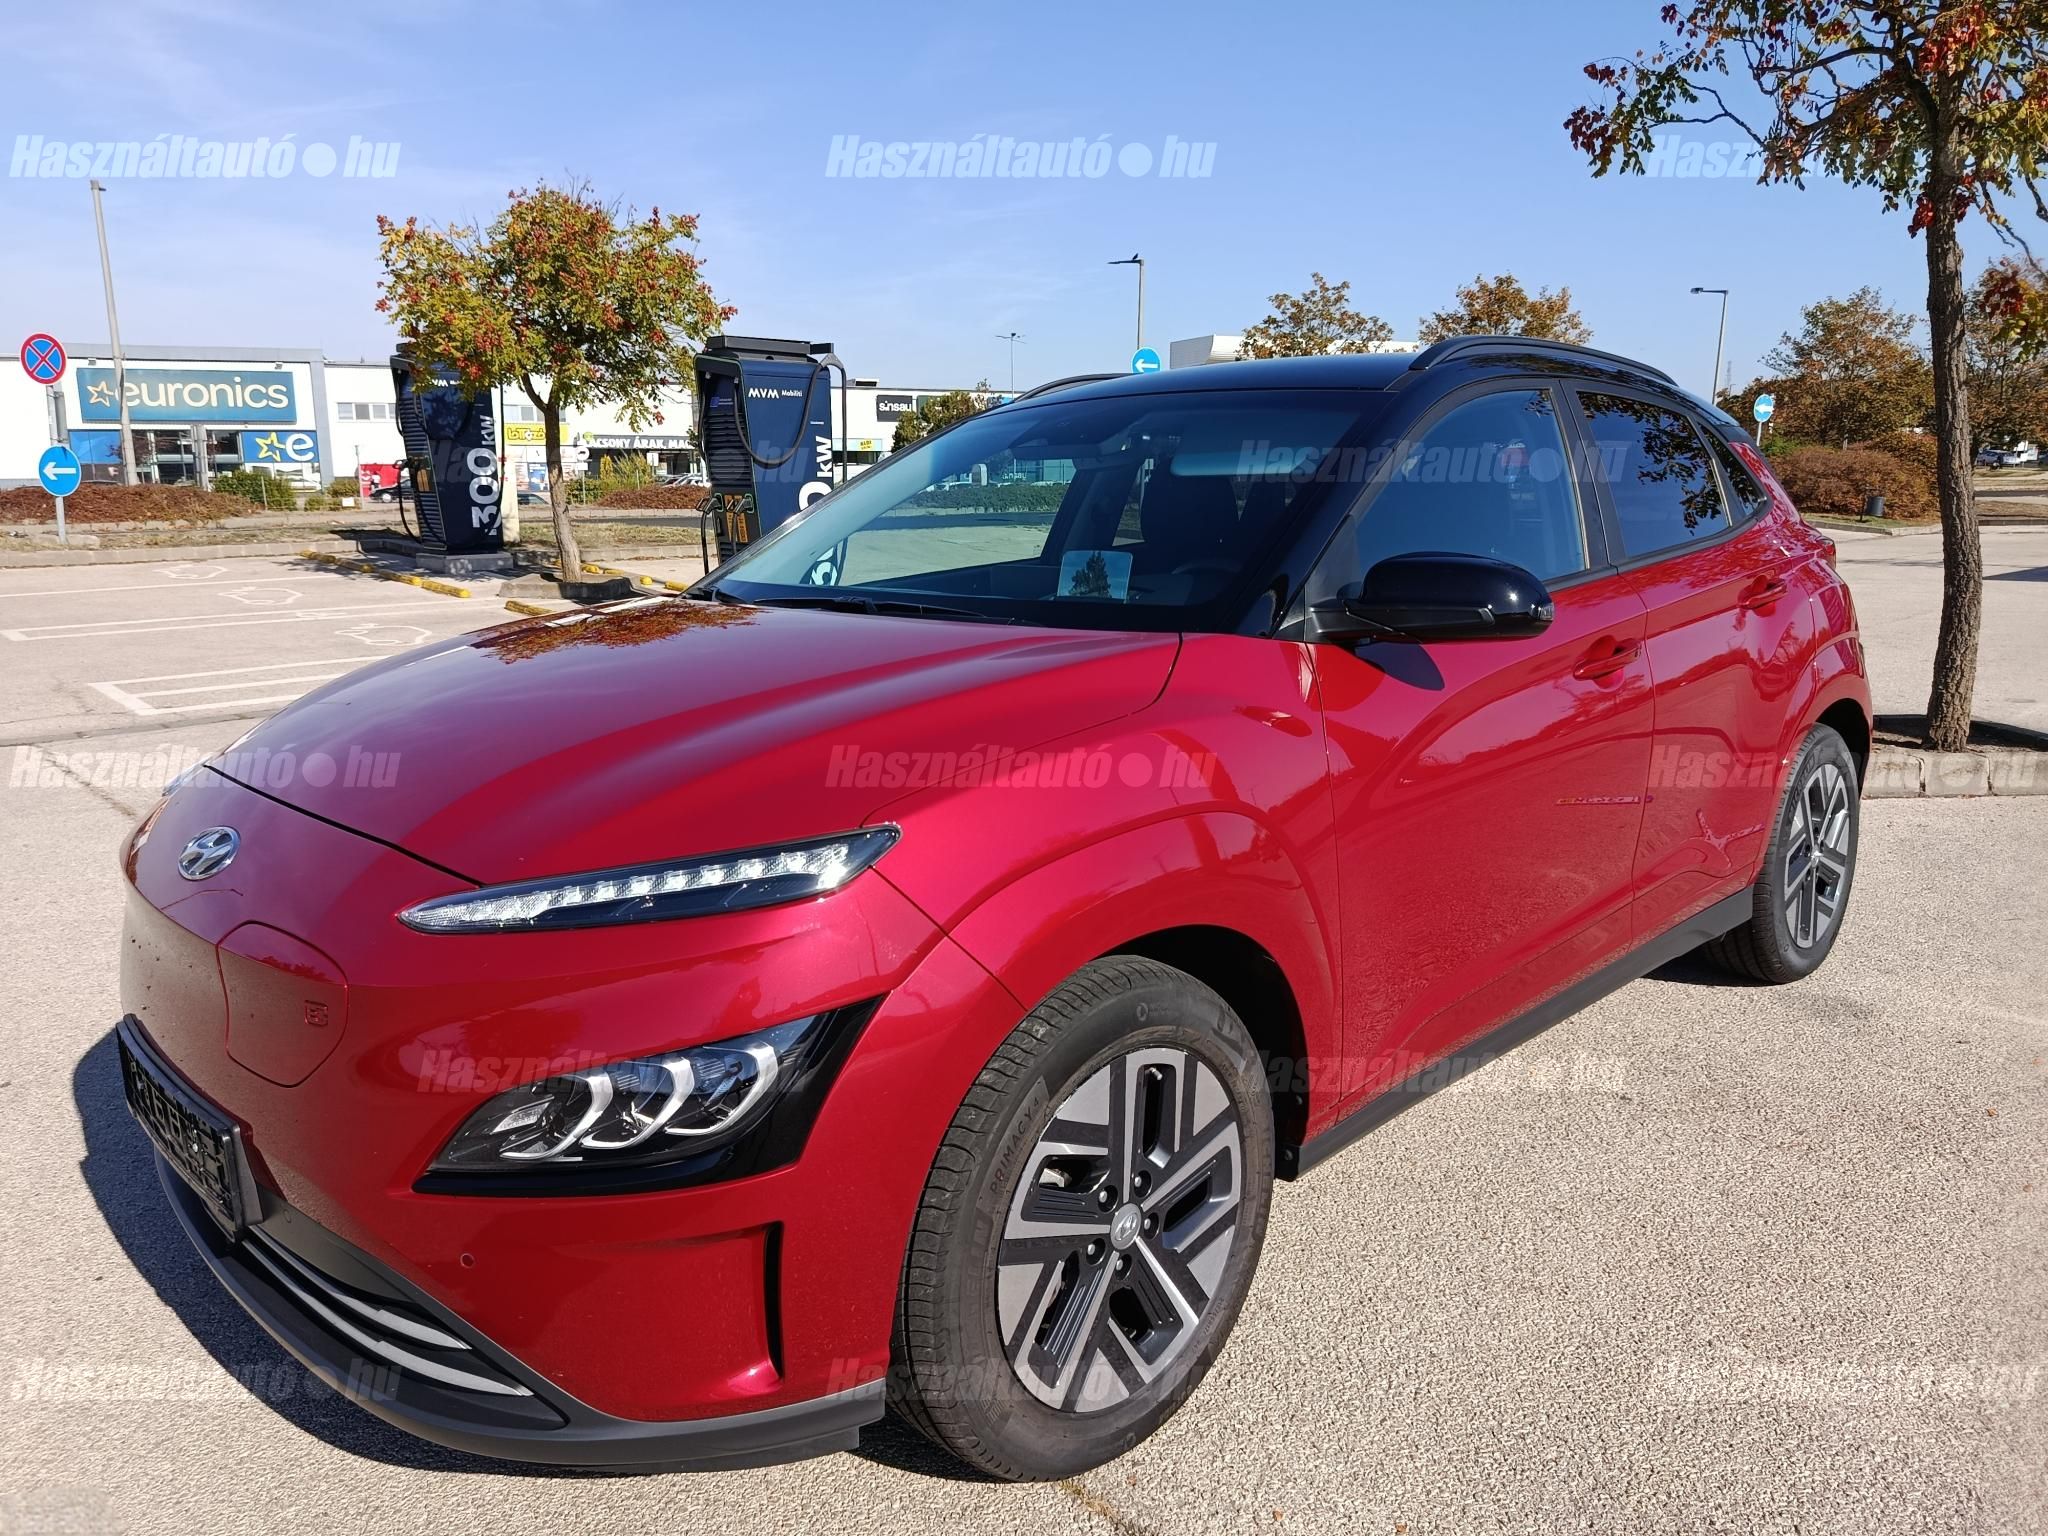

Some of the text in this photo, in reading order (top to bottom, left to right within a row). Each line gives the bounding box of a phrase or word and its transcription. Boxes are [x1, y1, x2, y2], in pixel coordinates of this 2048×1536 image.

[115, 376, 289, 409] euronics
[748, 387, 780, 399] MVM
[466, 413, 502, 529] 300 kW
[989, 1106, 1033, 1195] PRIMACY
